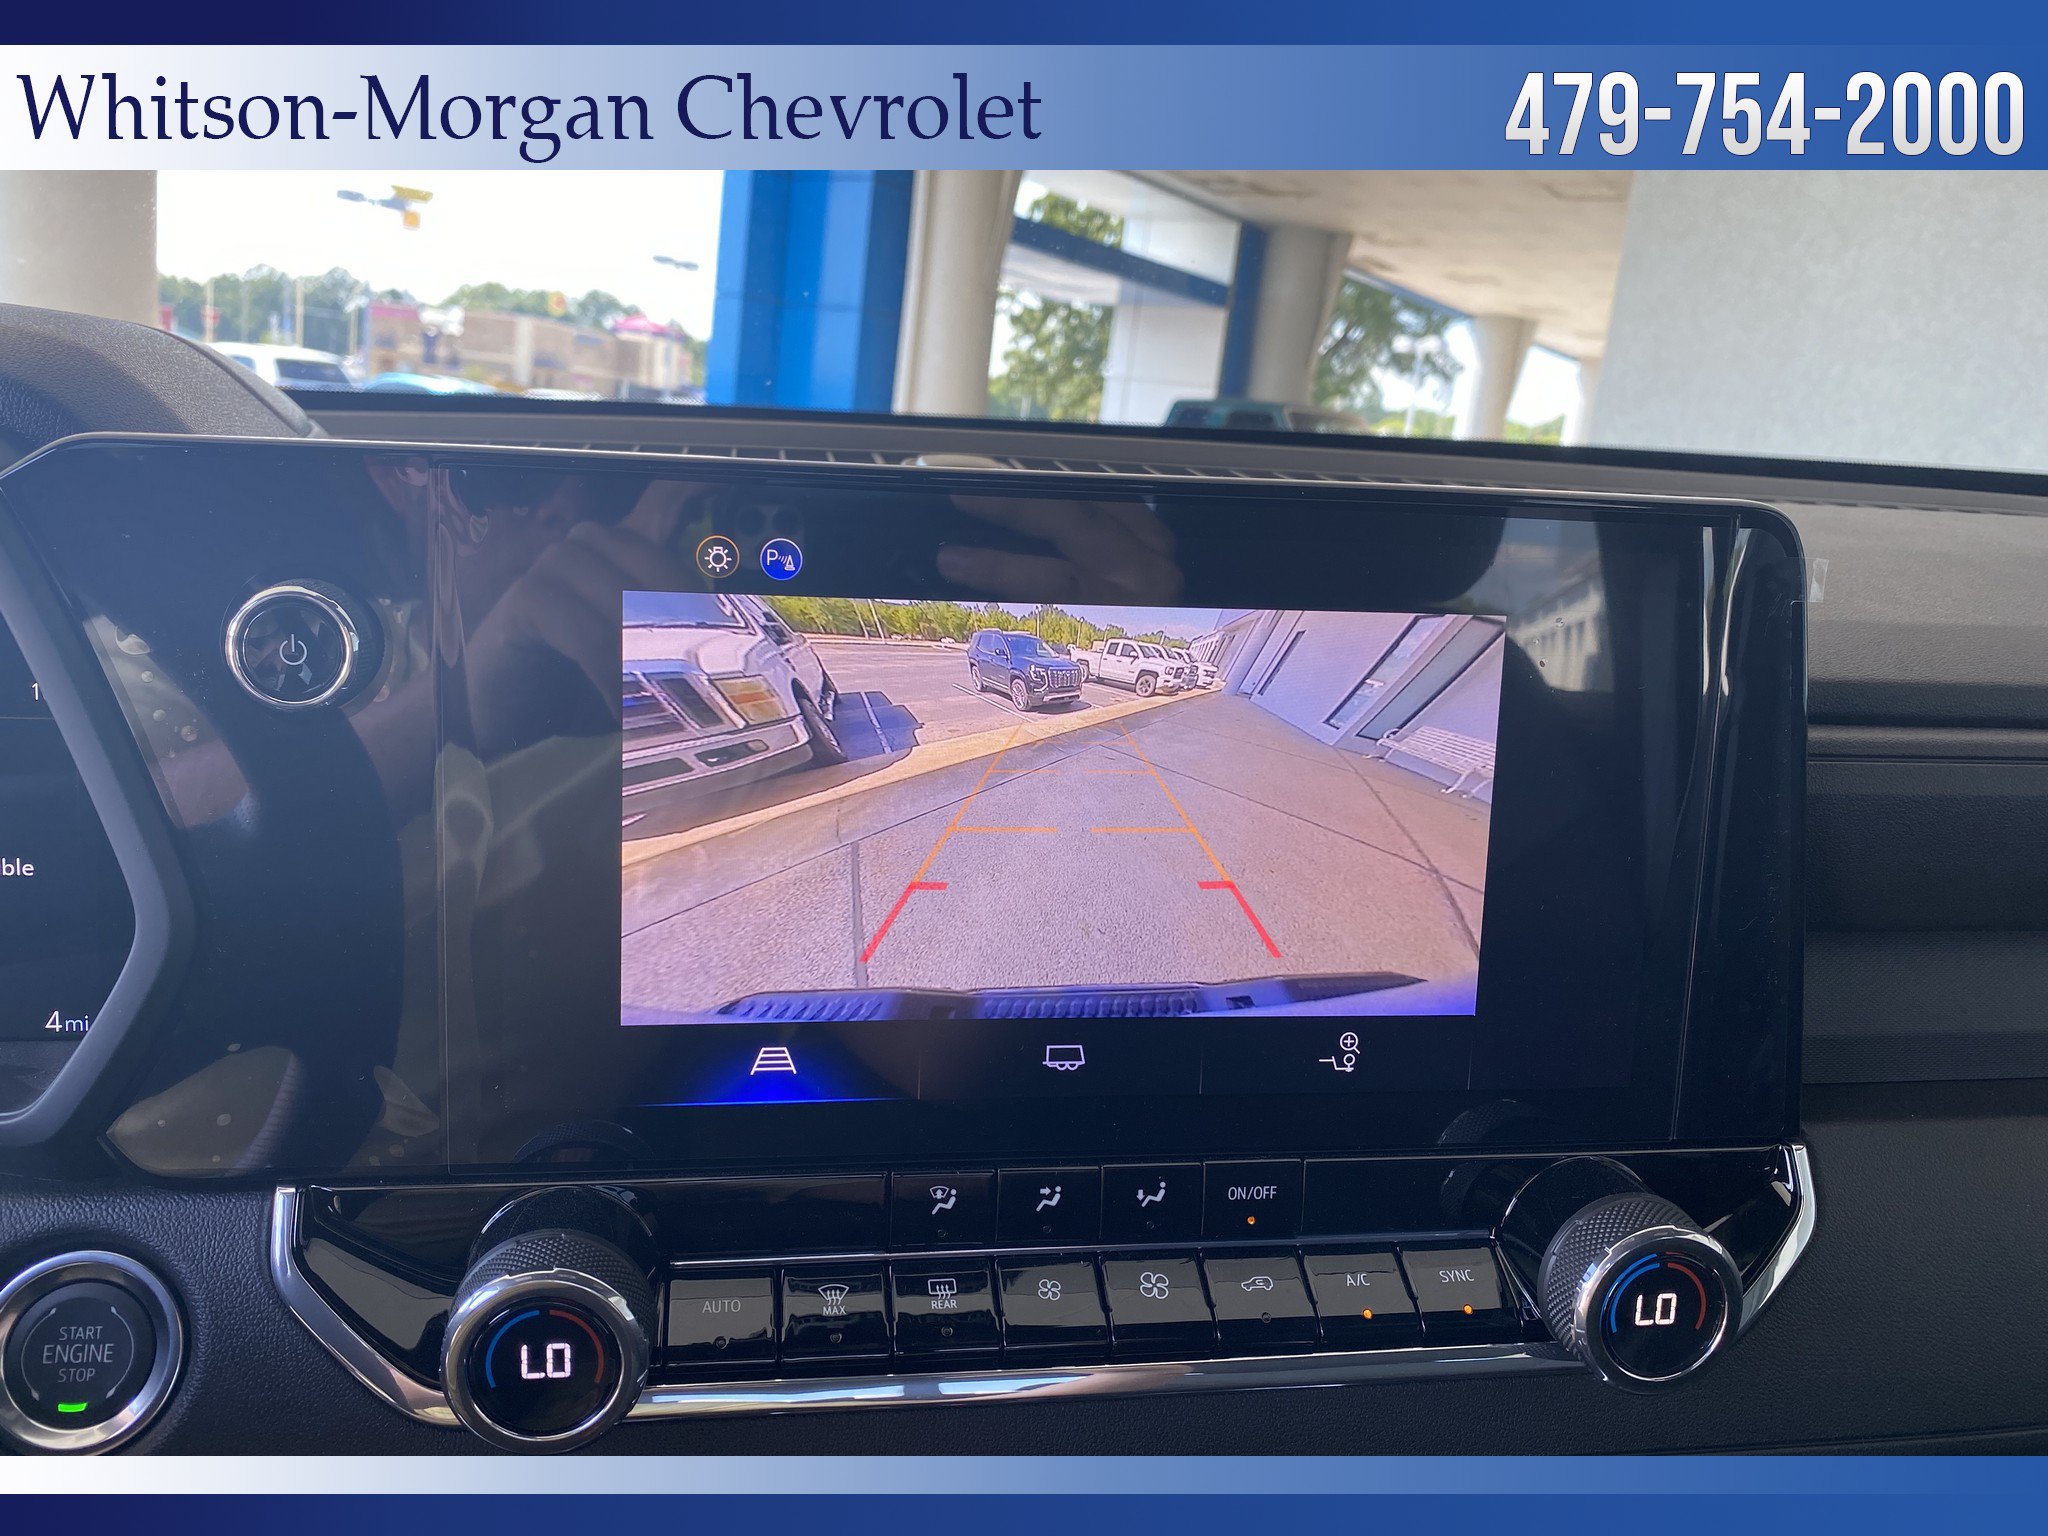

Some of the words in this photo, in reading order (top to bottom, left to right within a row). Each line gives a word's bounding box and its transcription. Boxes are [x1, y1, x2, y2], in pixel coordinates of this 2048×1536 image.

[1227, 1186, 1278, 1201] ON/OFF
[1346, 1273, 1371, 1288] A/C
[1438, 1269, 1475, 1284] SYNC
[702, 1299, 741, 1314] AUTO
[822, 1305, 847, 1316] MAX
[930, 1299, 958, 1310] REAR
[58, 1326, 103, 1341] START
[42, 1343, 114, 1365] ENGINE
[57, 1368, 96, 1383] STOP
